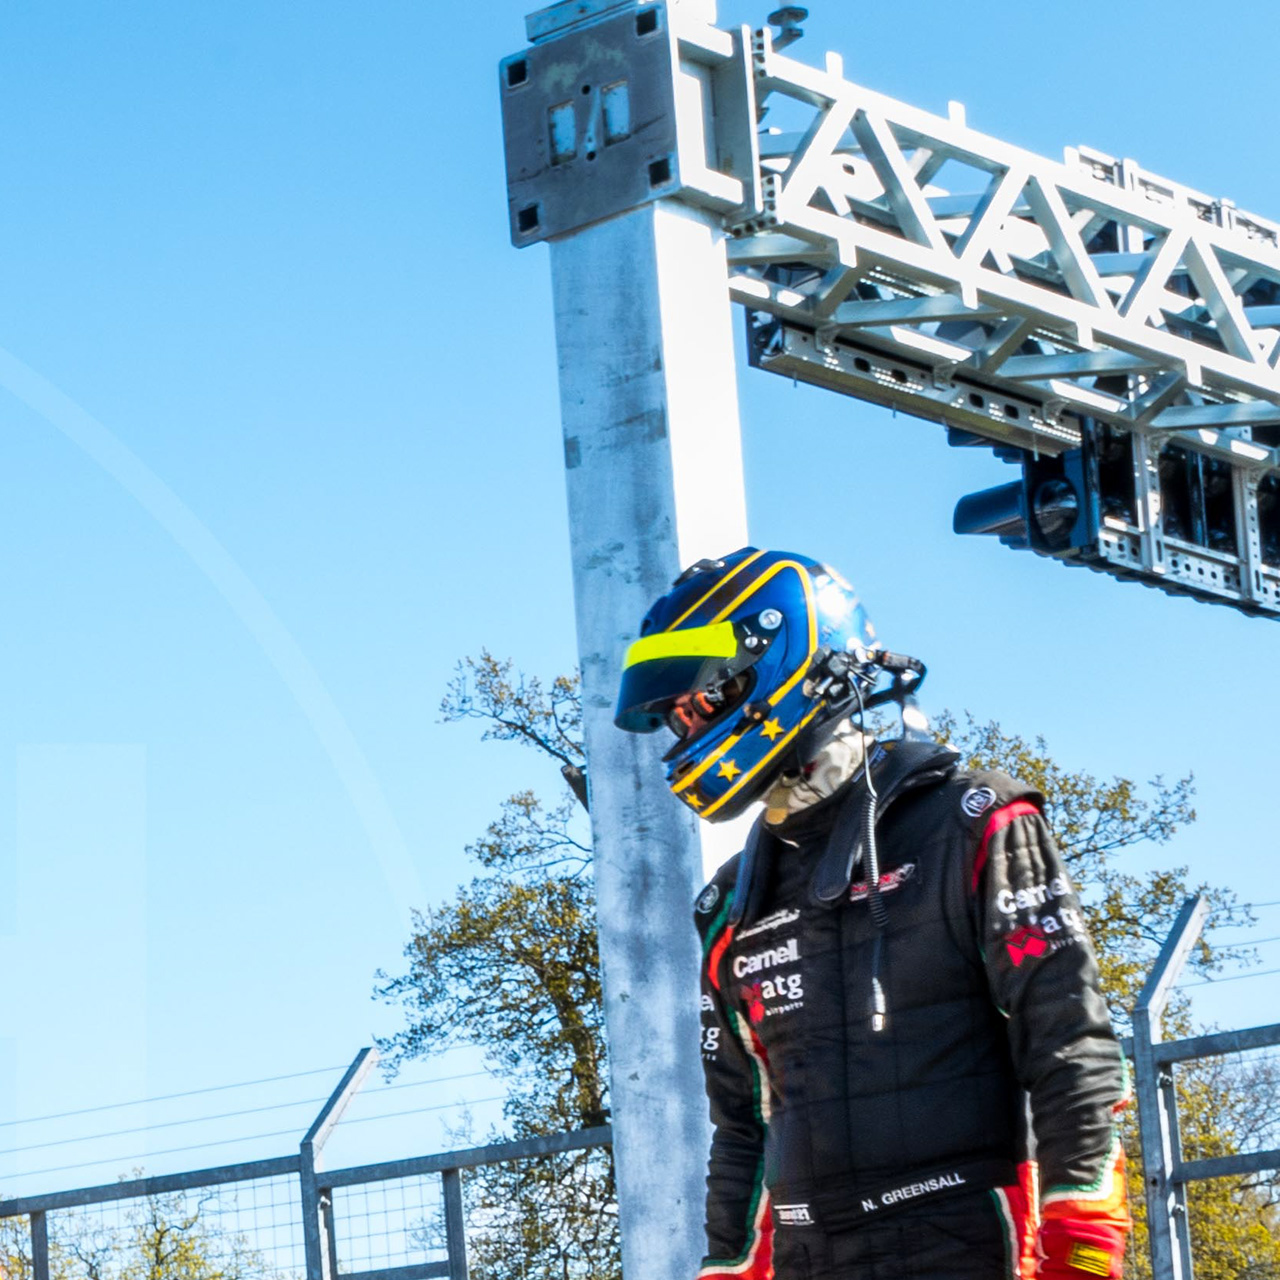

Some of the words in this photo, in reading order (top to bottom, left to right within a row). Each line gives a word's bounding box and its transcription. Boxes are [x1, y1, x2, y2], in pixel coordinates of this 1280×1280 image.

[761, 973, 804, 1000] atg
[861, 1200, 878, 1212] N.
[881, 1173, 966, 1205] GREENSALL
